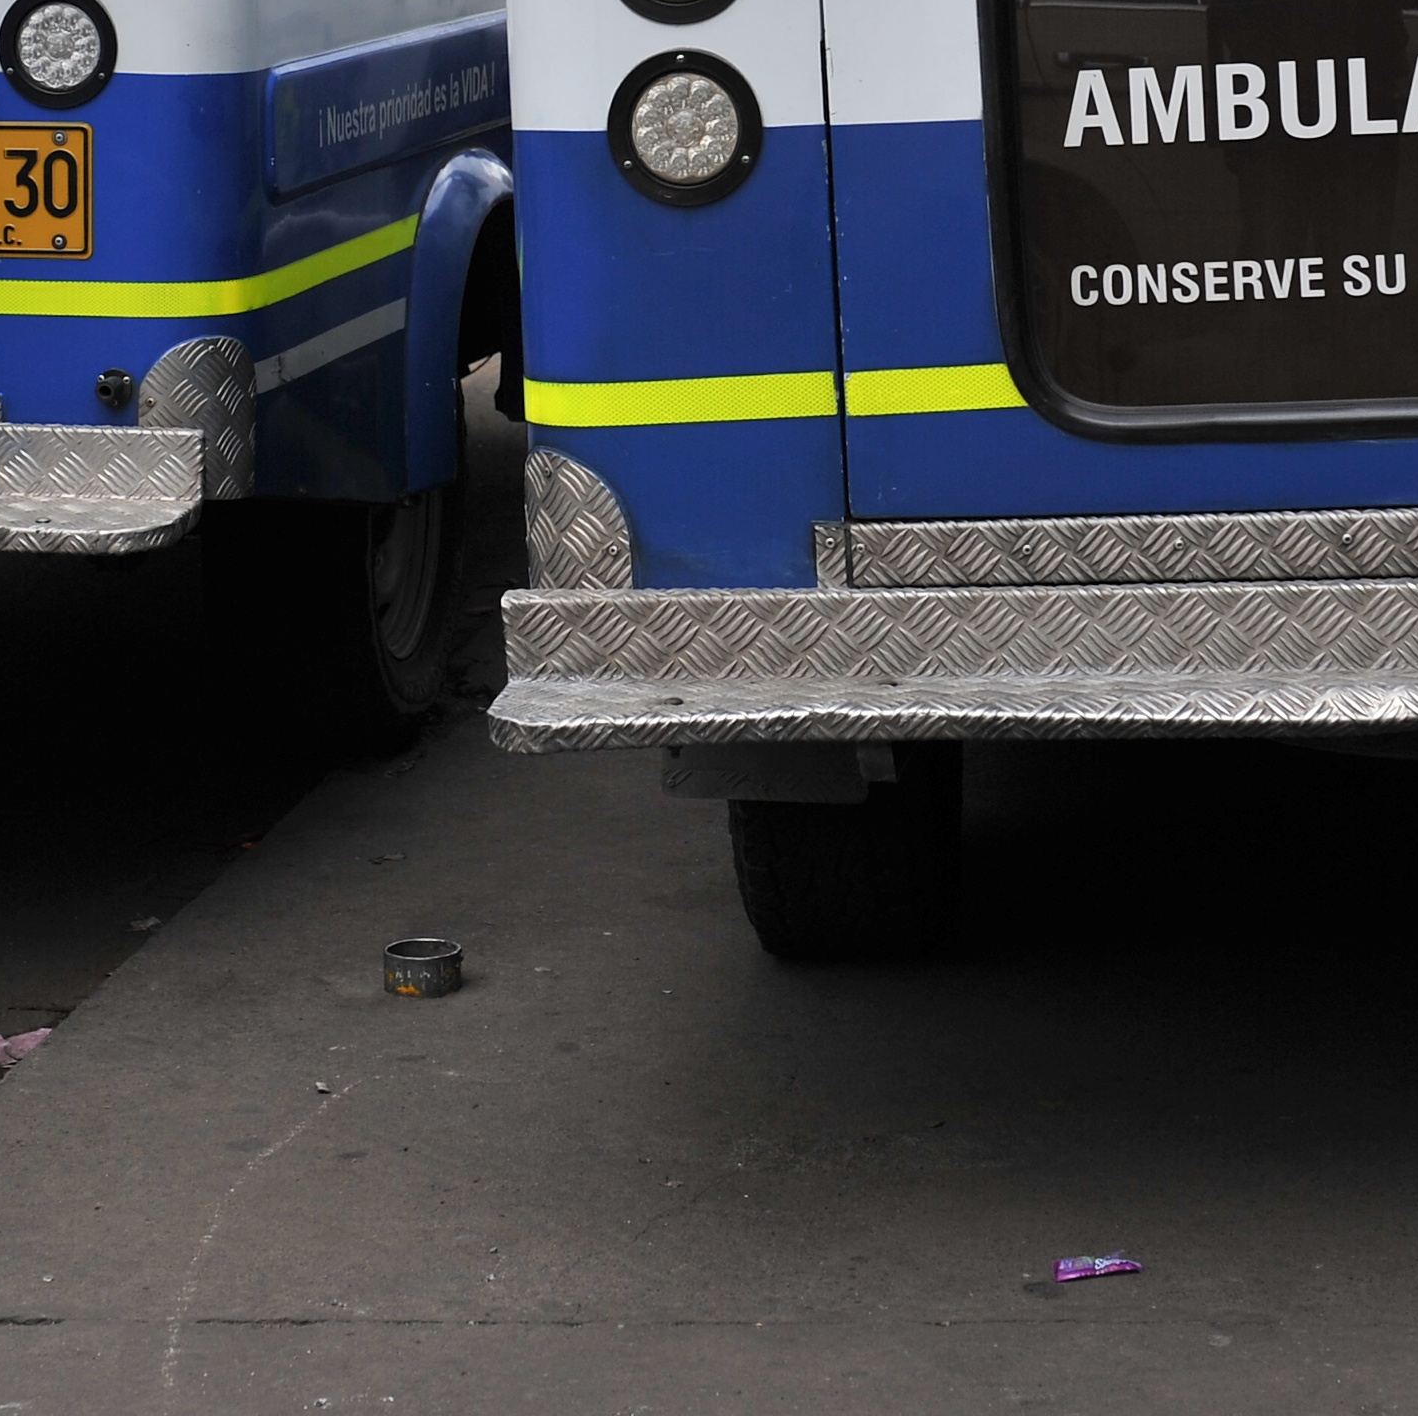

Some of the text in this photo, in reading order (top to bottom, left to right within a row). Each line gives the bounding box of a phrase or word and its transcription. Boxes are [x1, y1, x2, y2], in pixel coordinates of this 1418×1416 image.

[327, 99, 377, 146] Nuestra
[379, 78, 432, 140] prioridad
[434, 84, 448, 114] es
[449, 73, 460, 109] la
[461, 62, 489, 105] VIDA
[1070, 257, 1326, 307] CONSERVE
[1343, 254, 1408, 297] SU
